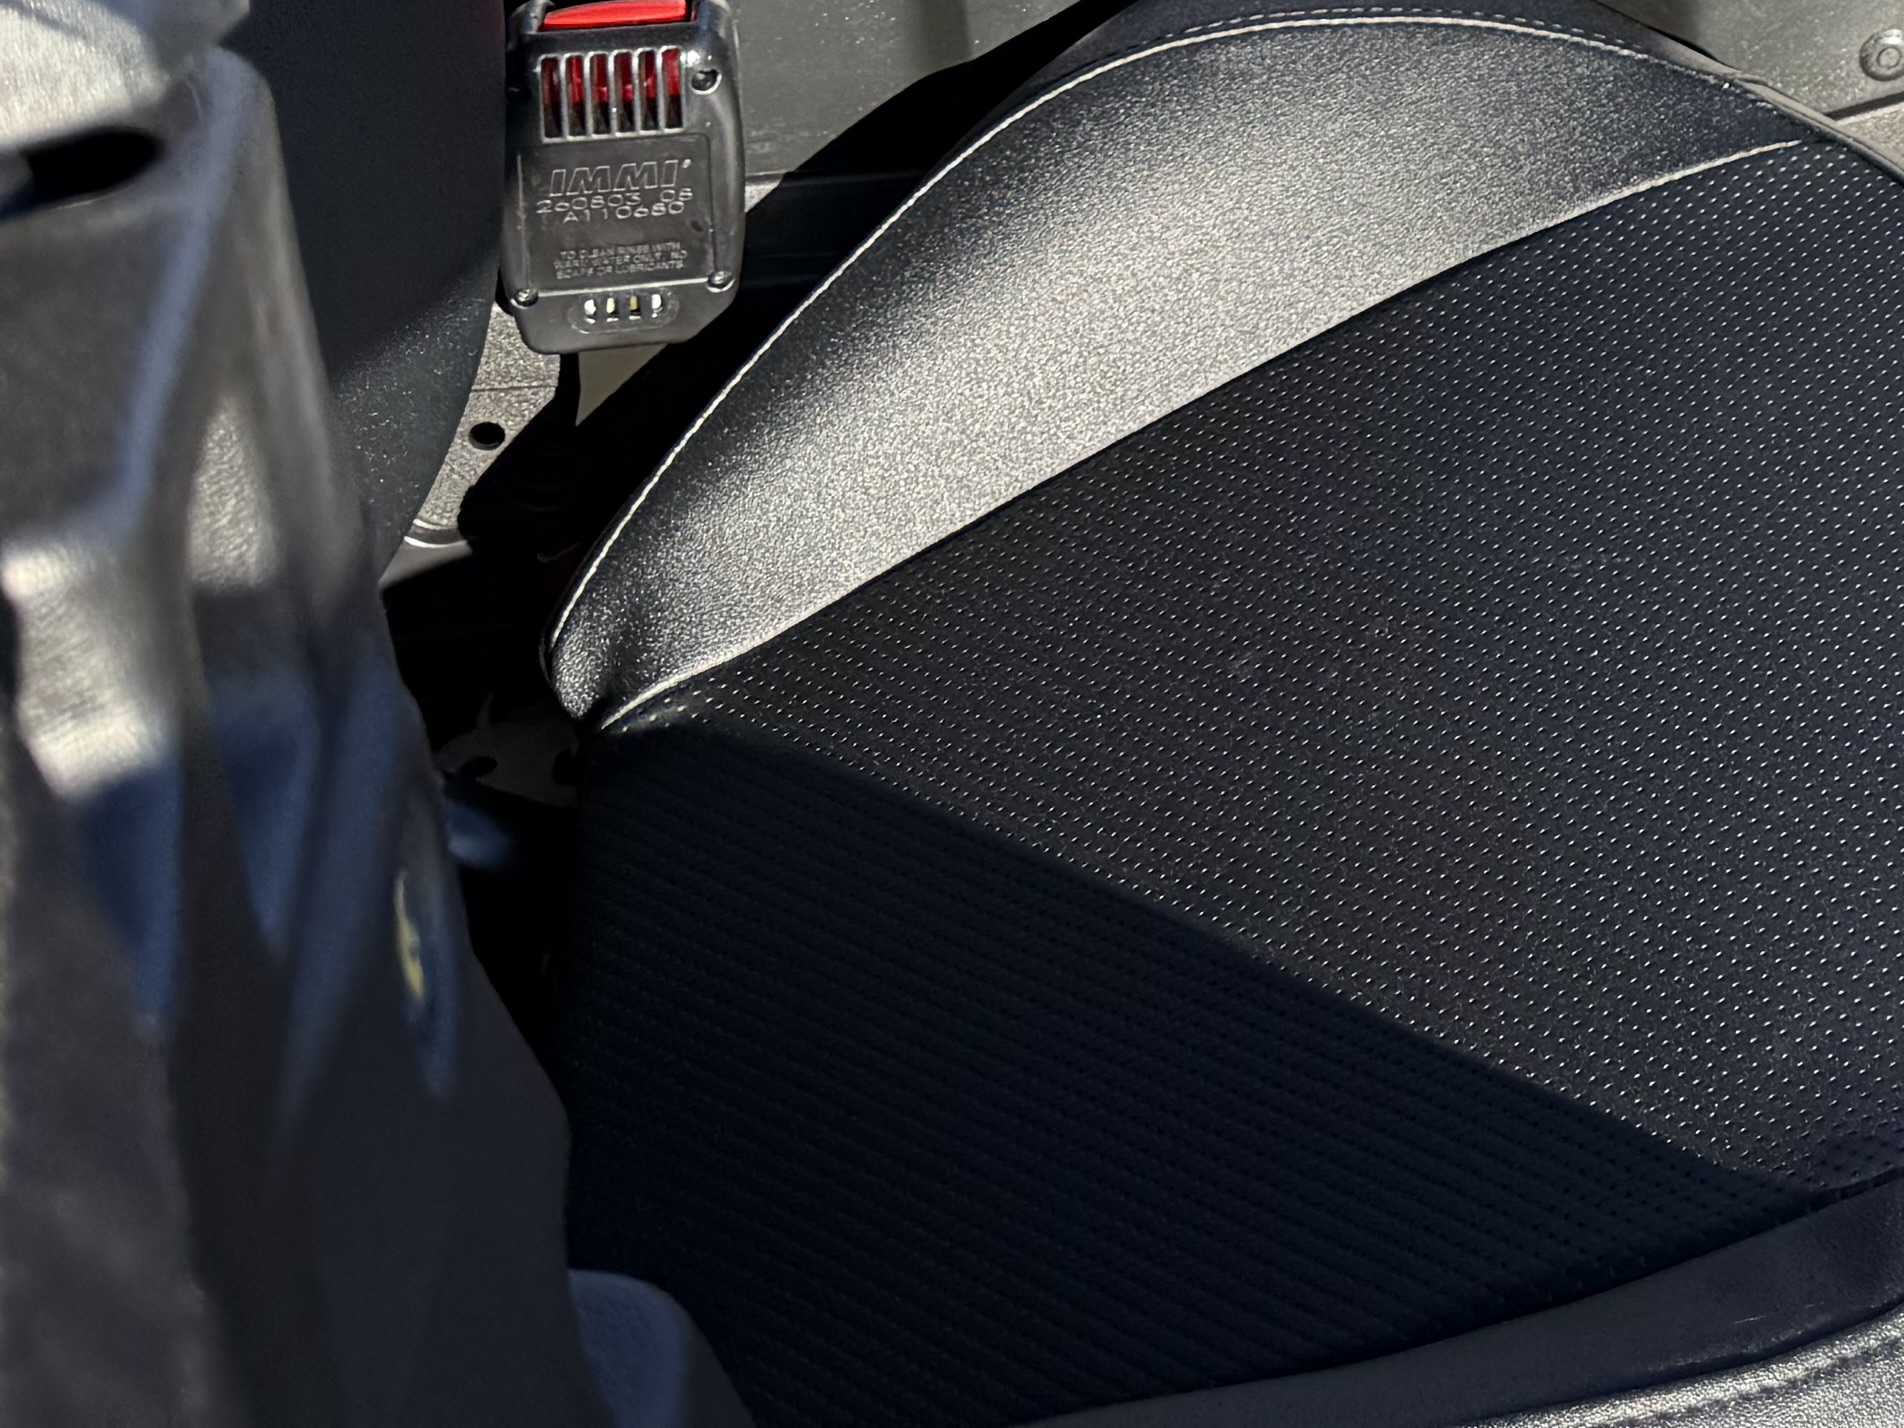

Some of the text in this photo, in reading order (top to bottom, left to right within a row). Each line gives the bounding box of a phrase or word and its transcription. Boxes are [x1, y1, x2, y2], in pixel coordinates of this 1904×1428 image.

[549, 159, 679, 197] IMMI
[536, 188, 693, 214] 260803 08
[563, 201, 684, 224] A110680
[560, 250, 576, 260] TO
